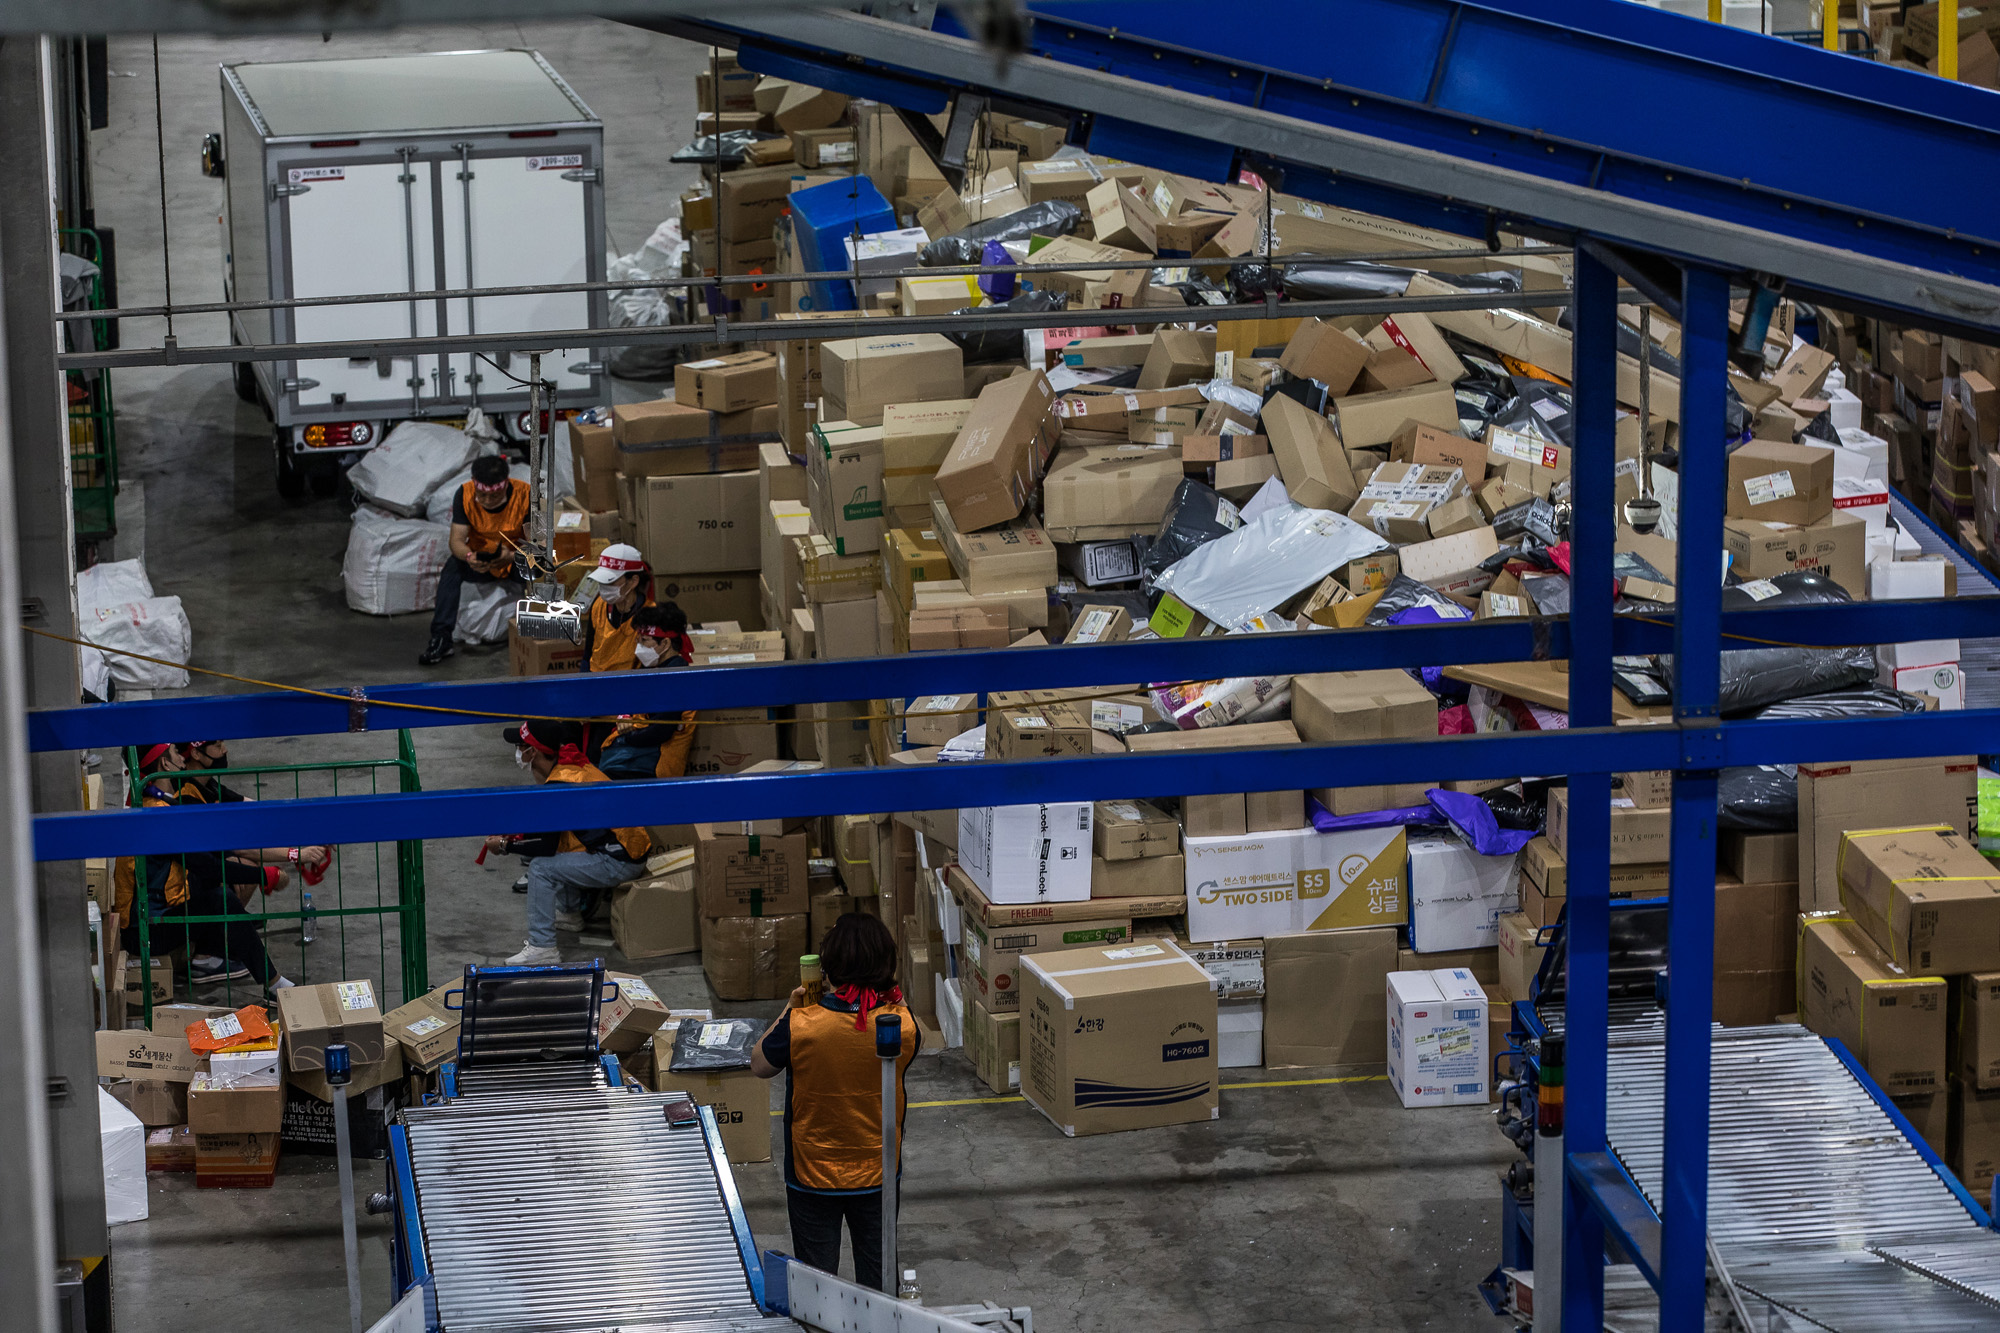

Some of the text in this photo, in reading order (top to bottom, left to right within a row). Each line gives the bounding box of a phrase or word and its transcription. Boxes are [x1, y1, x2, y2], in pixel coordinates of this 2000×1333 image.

[989, 137, 1029, 157] EMPUR
[1340, 216, 1434, 243] MANDARINA
[698, 520, 734, 530] 750 cc
[1794, 557, 1819, 569] CINEMA
[714, 580, 733, 592] ON
[547, 661, 565, 671] AIR
[1217, 846, 1242, 854] SENSE
[1344, 861, 1364, 879] 10cm
[1303, 873, 1324, 888] SS
[1366, 876, 1399, 896] 슈퍼
[1223, 889, 1293, 907] TWO SIDE
[1367, 895, 1400, 914] 싱글
[1086, 1018, 1105, 1033] 한강
[128, 1049, 173, 1062] SG 세계물산
